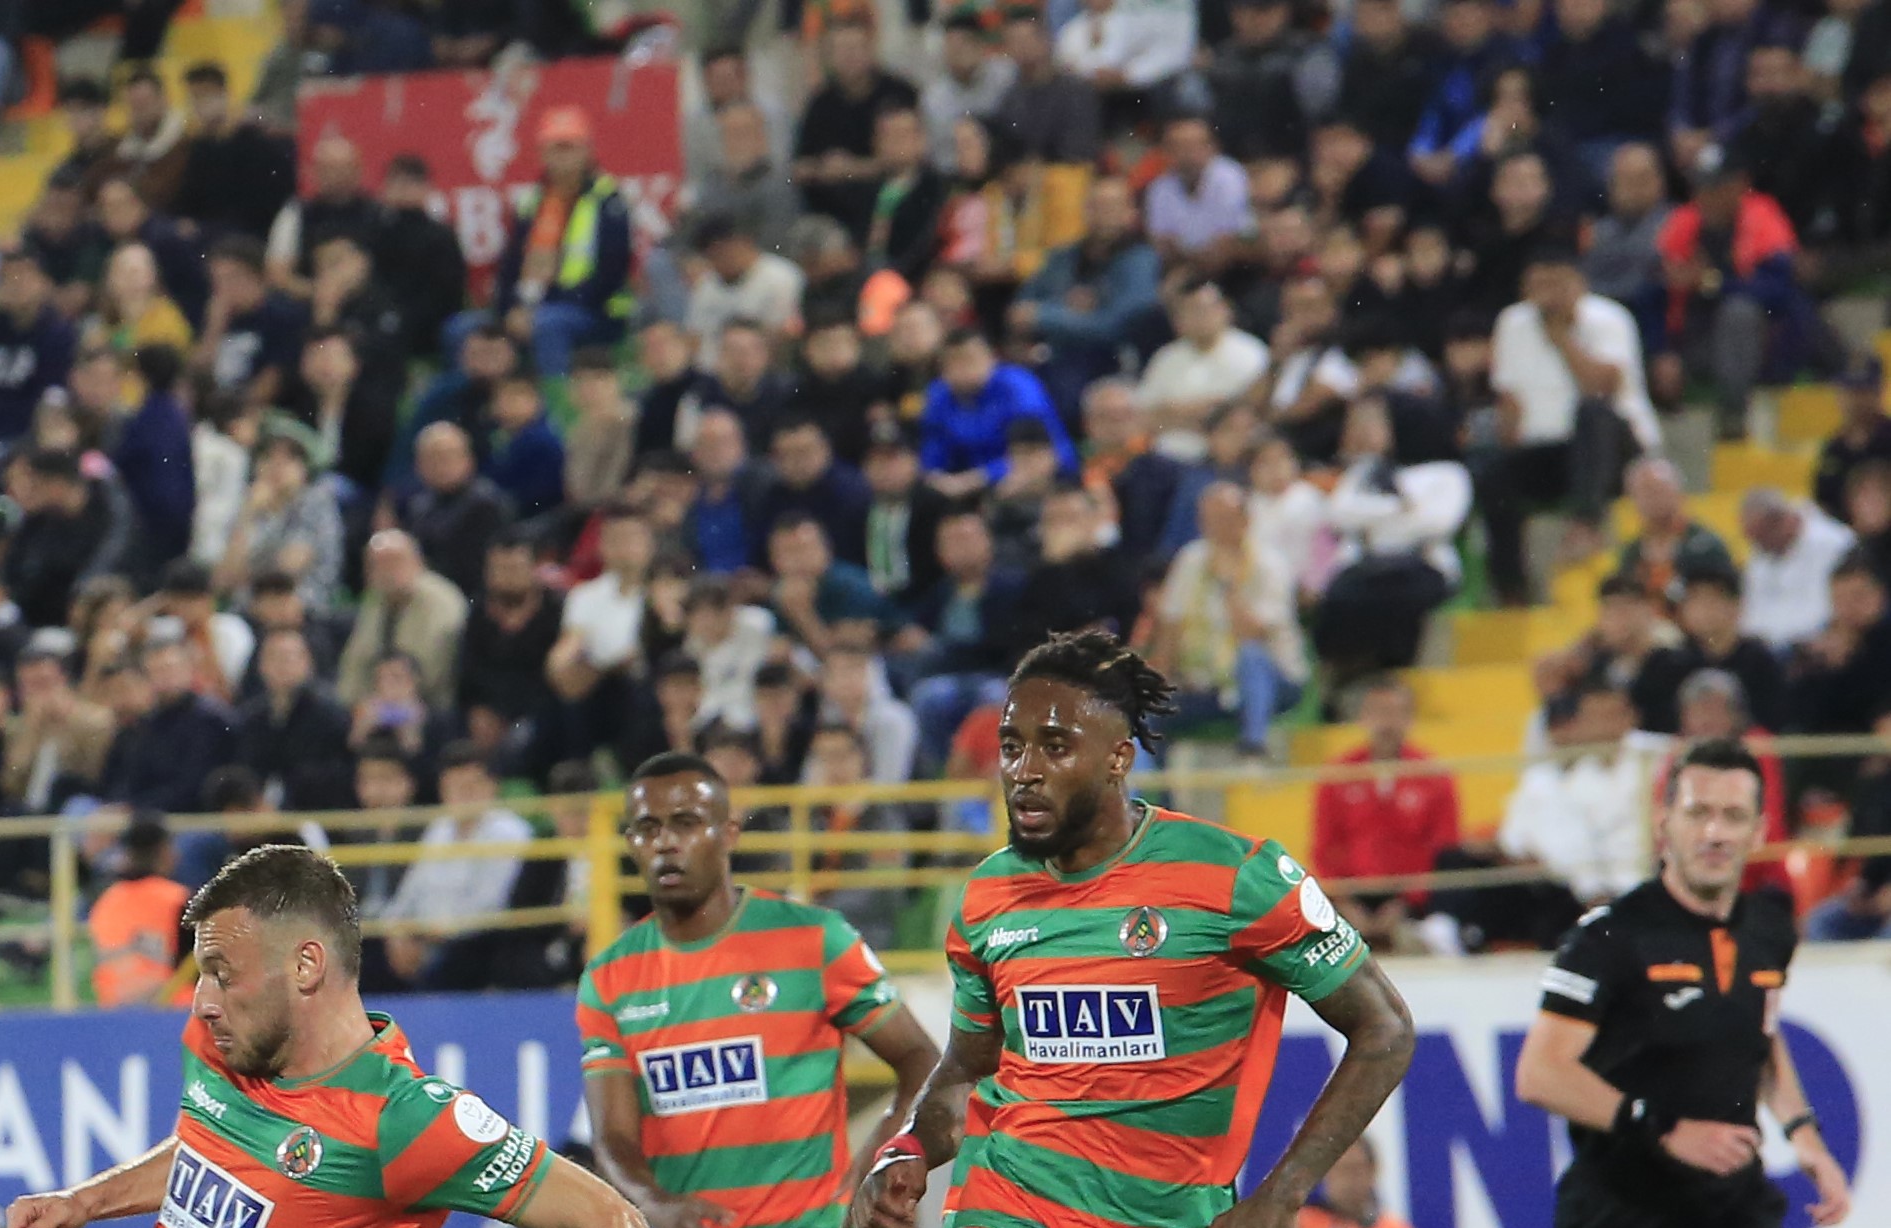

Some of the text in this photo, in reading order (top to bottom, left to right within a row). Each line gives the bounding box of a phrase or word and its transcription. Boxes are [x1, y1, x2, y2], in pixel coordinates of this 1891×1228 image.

[1029, 998, 1143, 1033] TAV
[1028, 1040, 1158, 1058] Havalimanları
[648, 1047, 754, 1091] TAV
